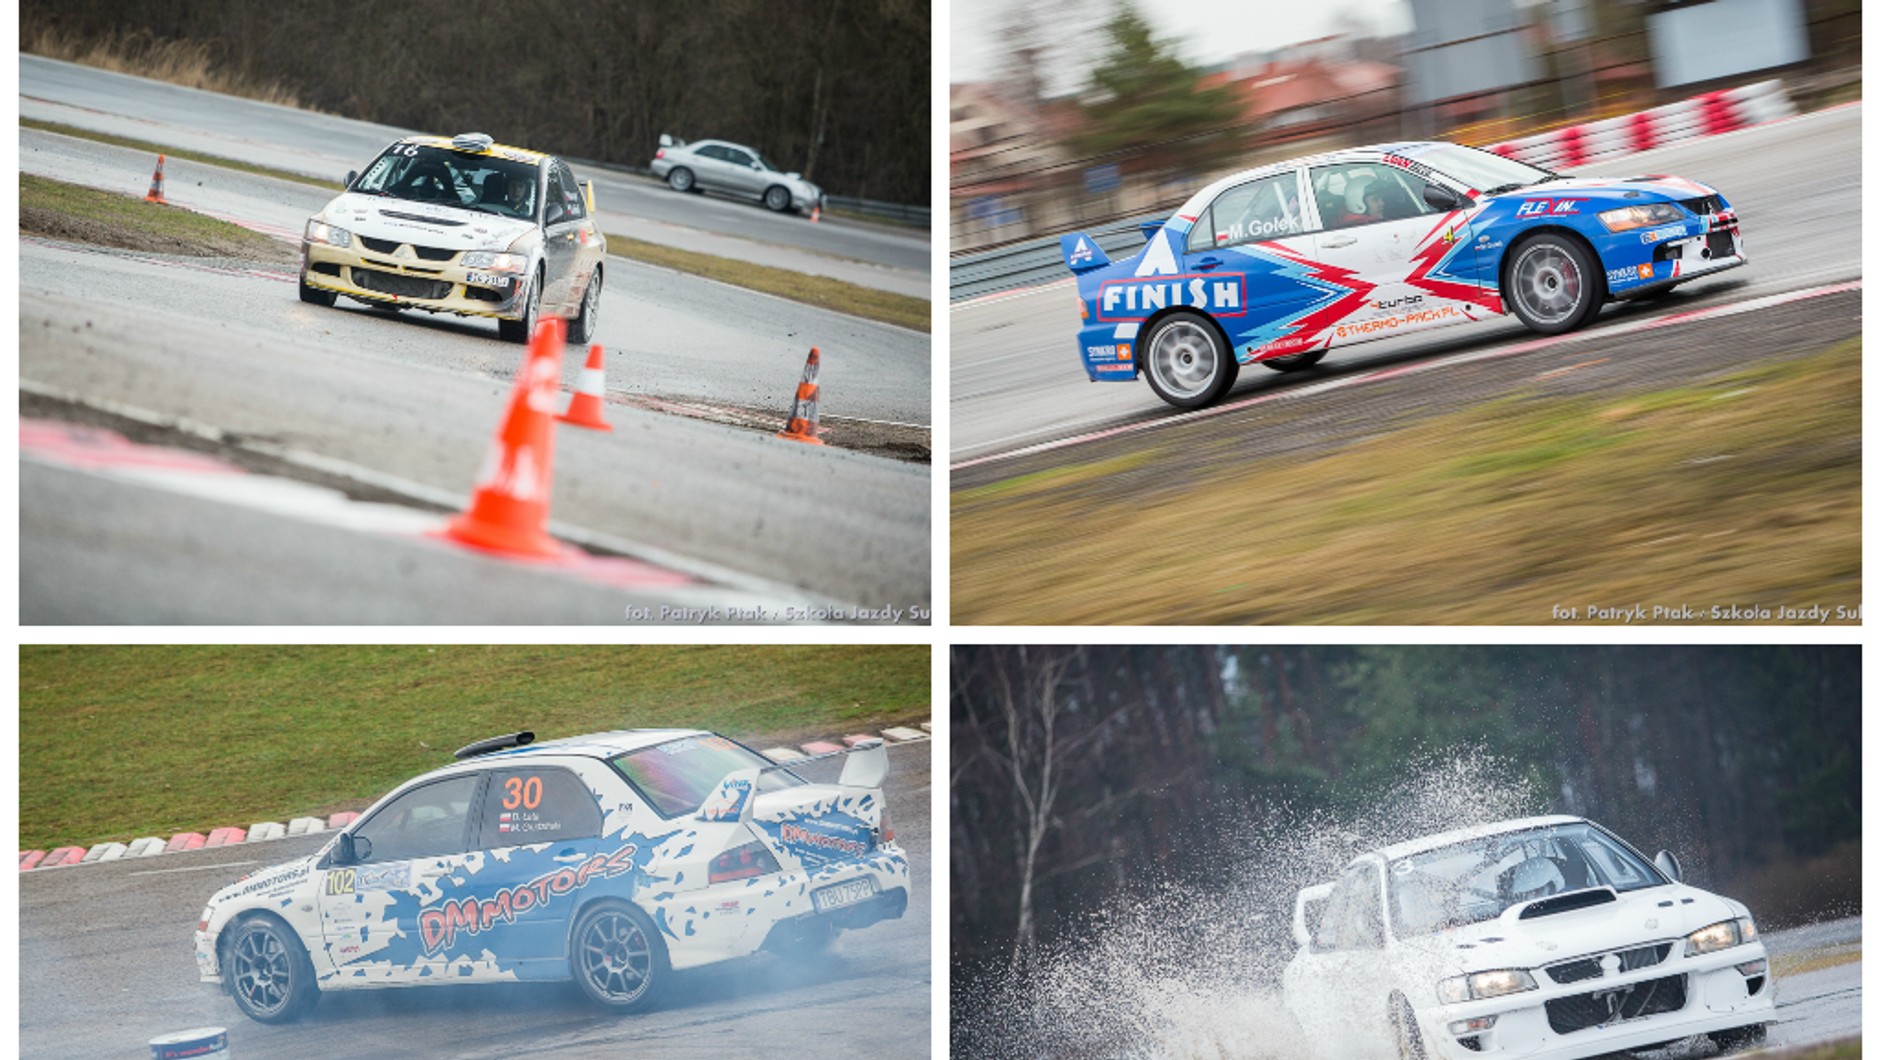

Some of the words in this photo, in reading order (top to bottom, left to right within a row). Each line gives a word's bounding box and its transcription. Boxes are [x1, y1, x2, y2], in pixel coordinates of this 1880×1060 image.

[392, 144, 420, 157] 16
[1103, 278, 1239, 311] FINISH
[502, 776, 543, 809] 30
[328, 869, 356, 895] 102
